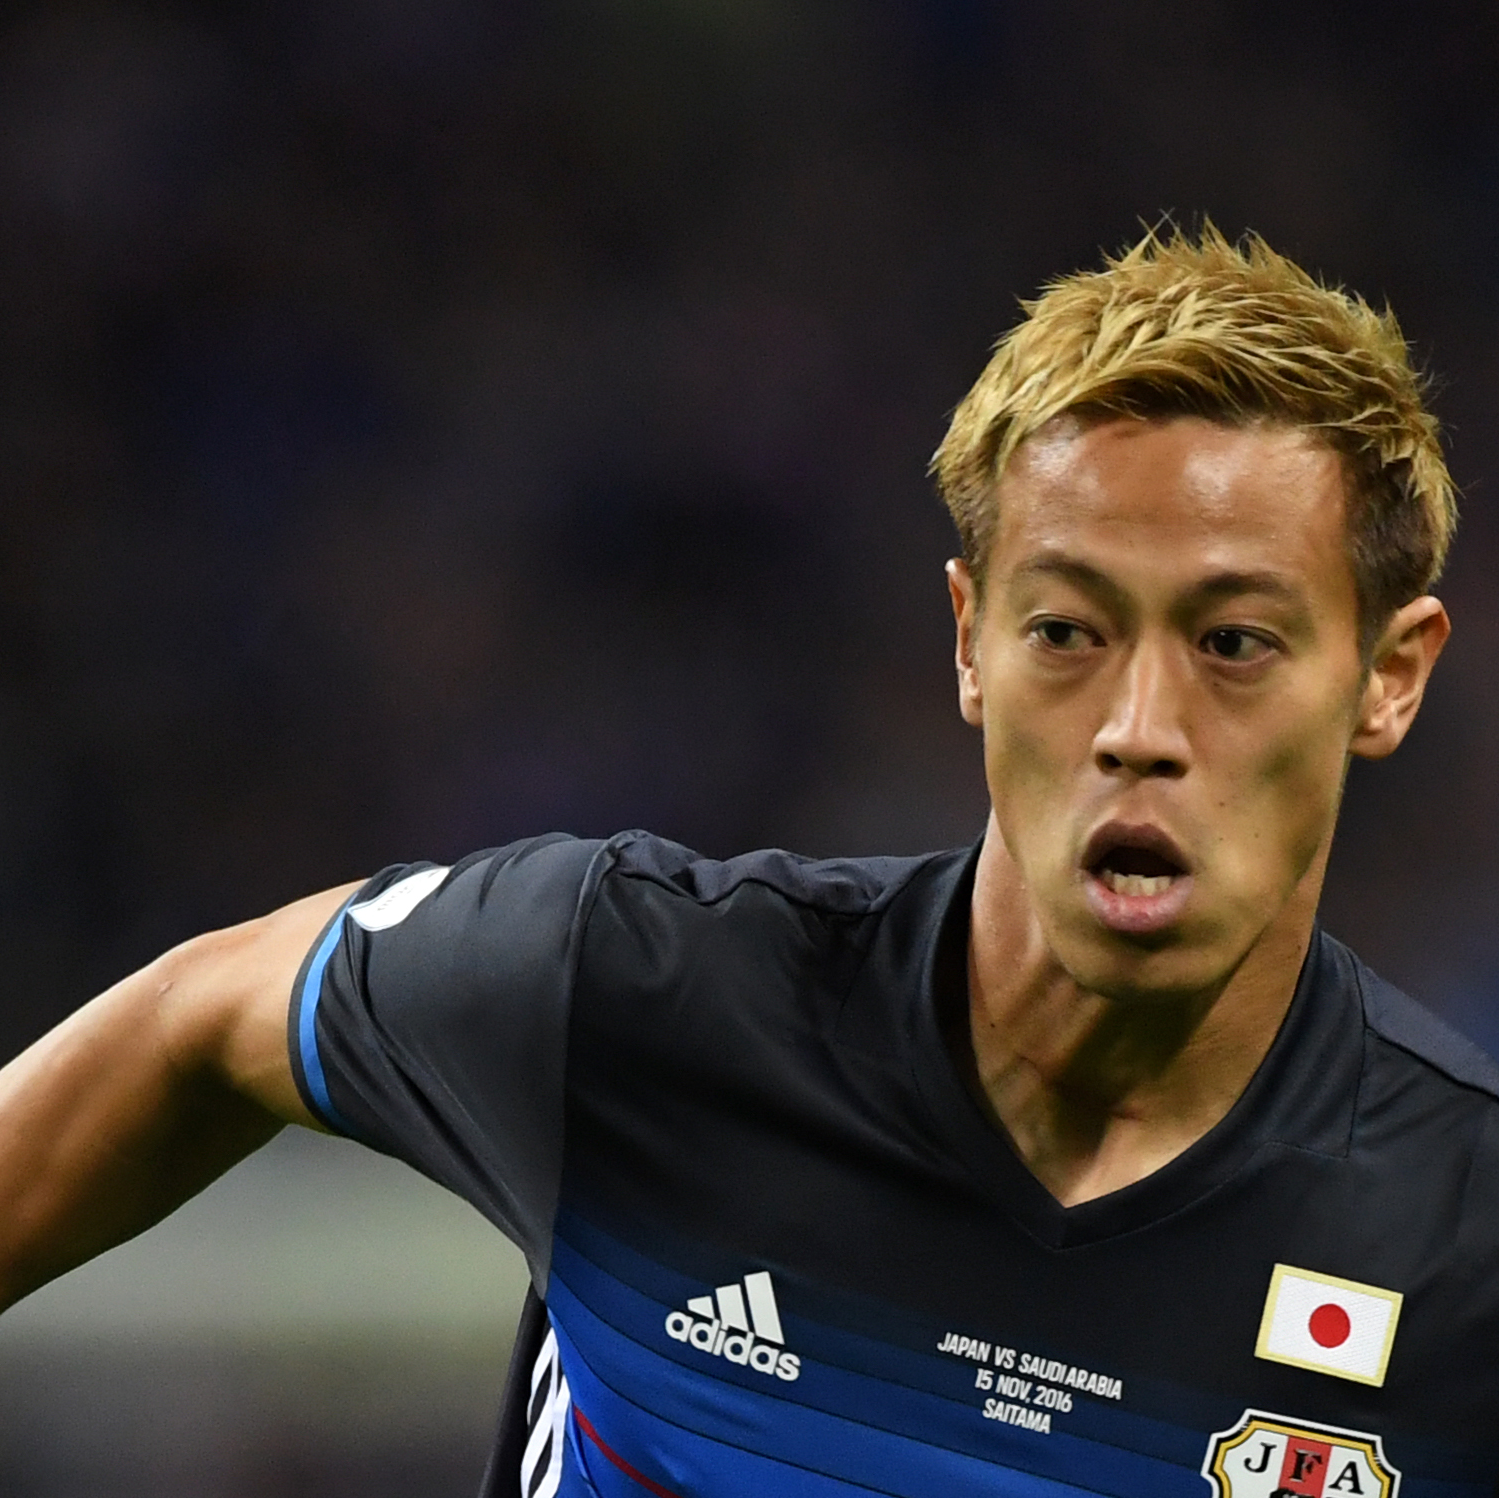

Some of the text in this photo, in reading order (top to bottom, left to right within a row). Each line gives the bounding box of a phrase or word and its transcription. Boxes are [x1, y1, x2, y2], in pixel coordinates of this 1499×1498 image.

[665, 1311, 801, 1381] adidas
[936, 1332, 991, 1363] JAPAN
[994, 1346, 1017, 1369] VS
[975, 1368, 995, 1390] 15
[1033, 1385, 1073, 1413] 2016
[982, 1398, 1052, 1434] SAITAMA
[1243, 1442, 1365, 1496] JFA
